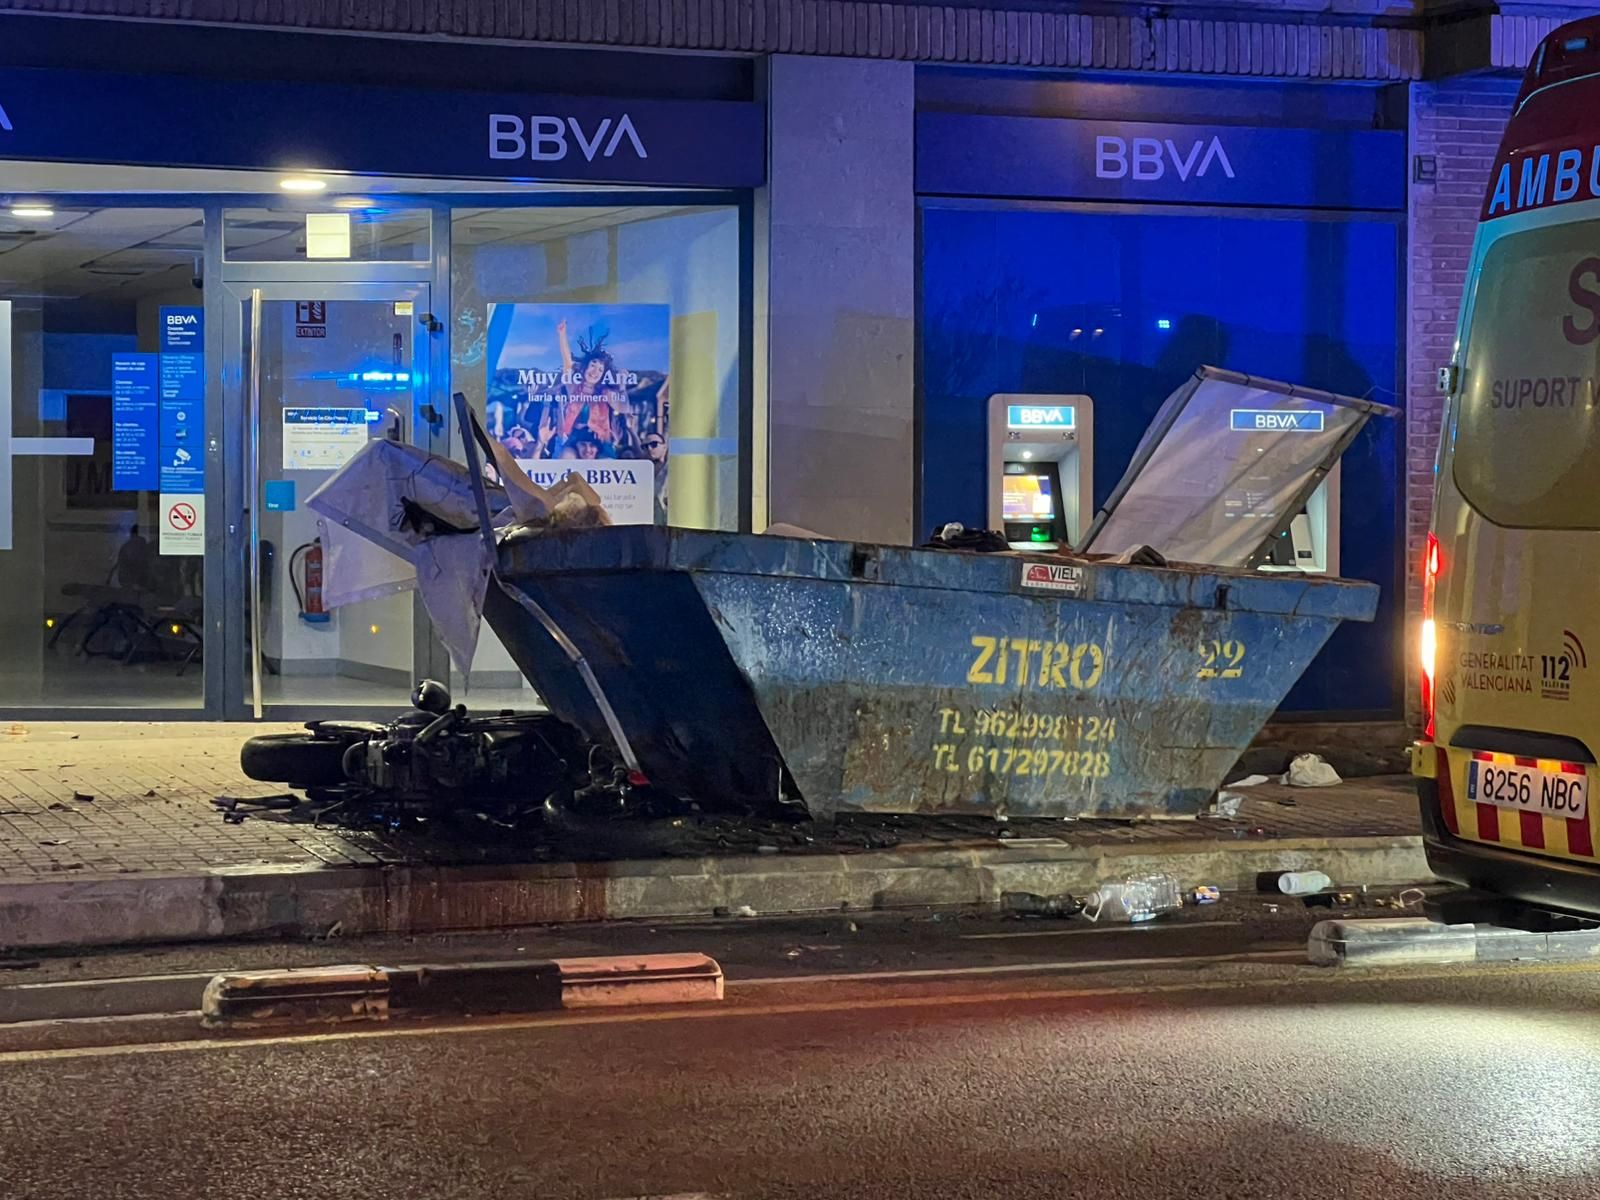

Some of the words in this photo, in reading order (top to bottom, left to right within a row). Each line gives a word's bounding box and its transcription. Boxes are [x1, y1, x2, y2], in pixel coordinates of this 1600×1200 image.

[489, 113, 648, 162] BBVA
[1096, 135, 1236, 183] BBVA
[167, 314, 198, 325] BBVA
[297, 327, 325, 337] EXTINTOR
[517, 370, 560, 388] Muy
[560, 369, 582, 385] de
[601, 370, 638, 386] Ana
[554, 394, 568, 403] en
[569, 393, 609, 405] primera
[1491, 376, 1581, 409] SUPORT
[1020, 408, 1064, 424] BBVA
[1255, 413, 1299, 429] BBVA
[587, 469, 637, 485] BBVA
[1050, 566, 1077, 581] VIEL
[967, 635, 1104, 690] ZITRO
[1460, 652, 1536, 673] GENERALITAT
[1541, 655, 1570, 681] 112
[1461, 673, 1533, 694] VALENCIANA
[938, 708, 966, 735] TL
[967, 744, 1110, 778] 617297828
[1482, 767, 1532, 805] 8256
[1540, 775, 1583, 812] NBC
